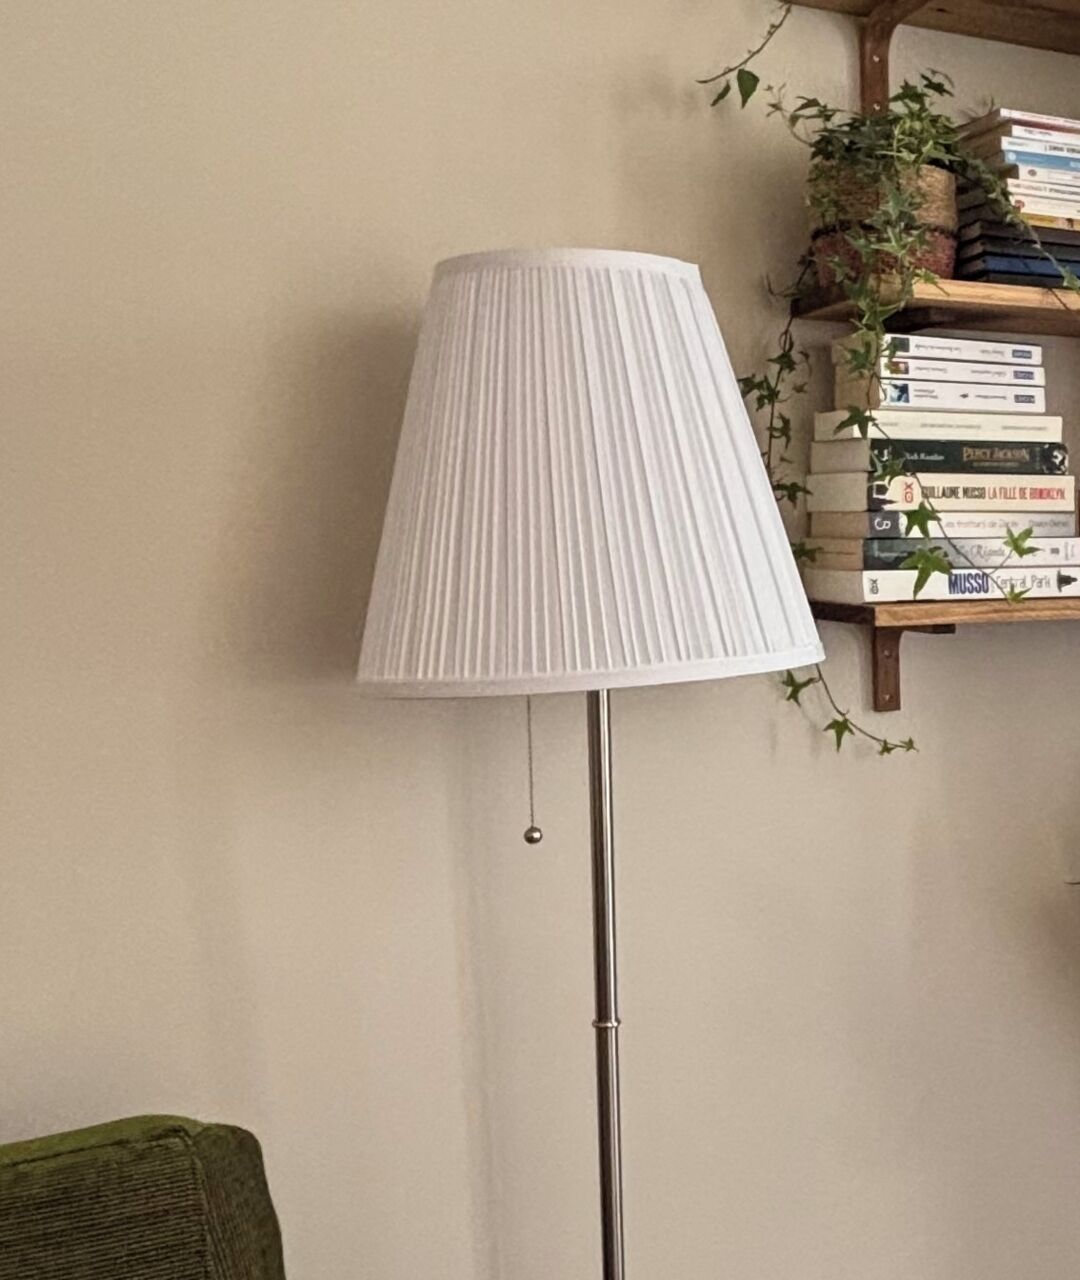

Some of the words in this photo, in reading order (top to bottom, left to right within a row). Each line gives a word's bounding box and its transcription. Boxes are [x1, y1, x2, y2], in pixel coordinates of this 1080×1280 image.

[922, 486, 961, 500] GUILLAUME
[987, 486, 998, 500] LA
[999, 486, 1017, 500] FILLE
[1018, 486, 1028, 500] DE
[948, 571, 990, 595] MUSSO
